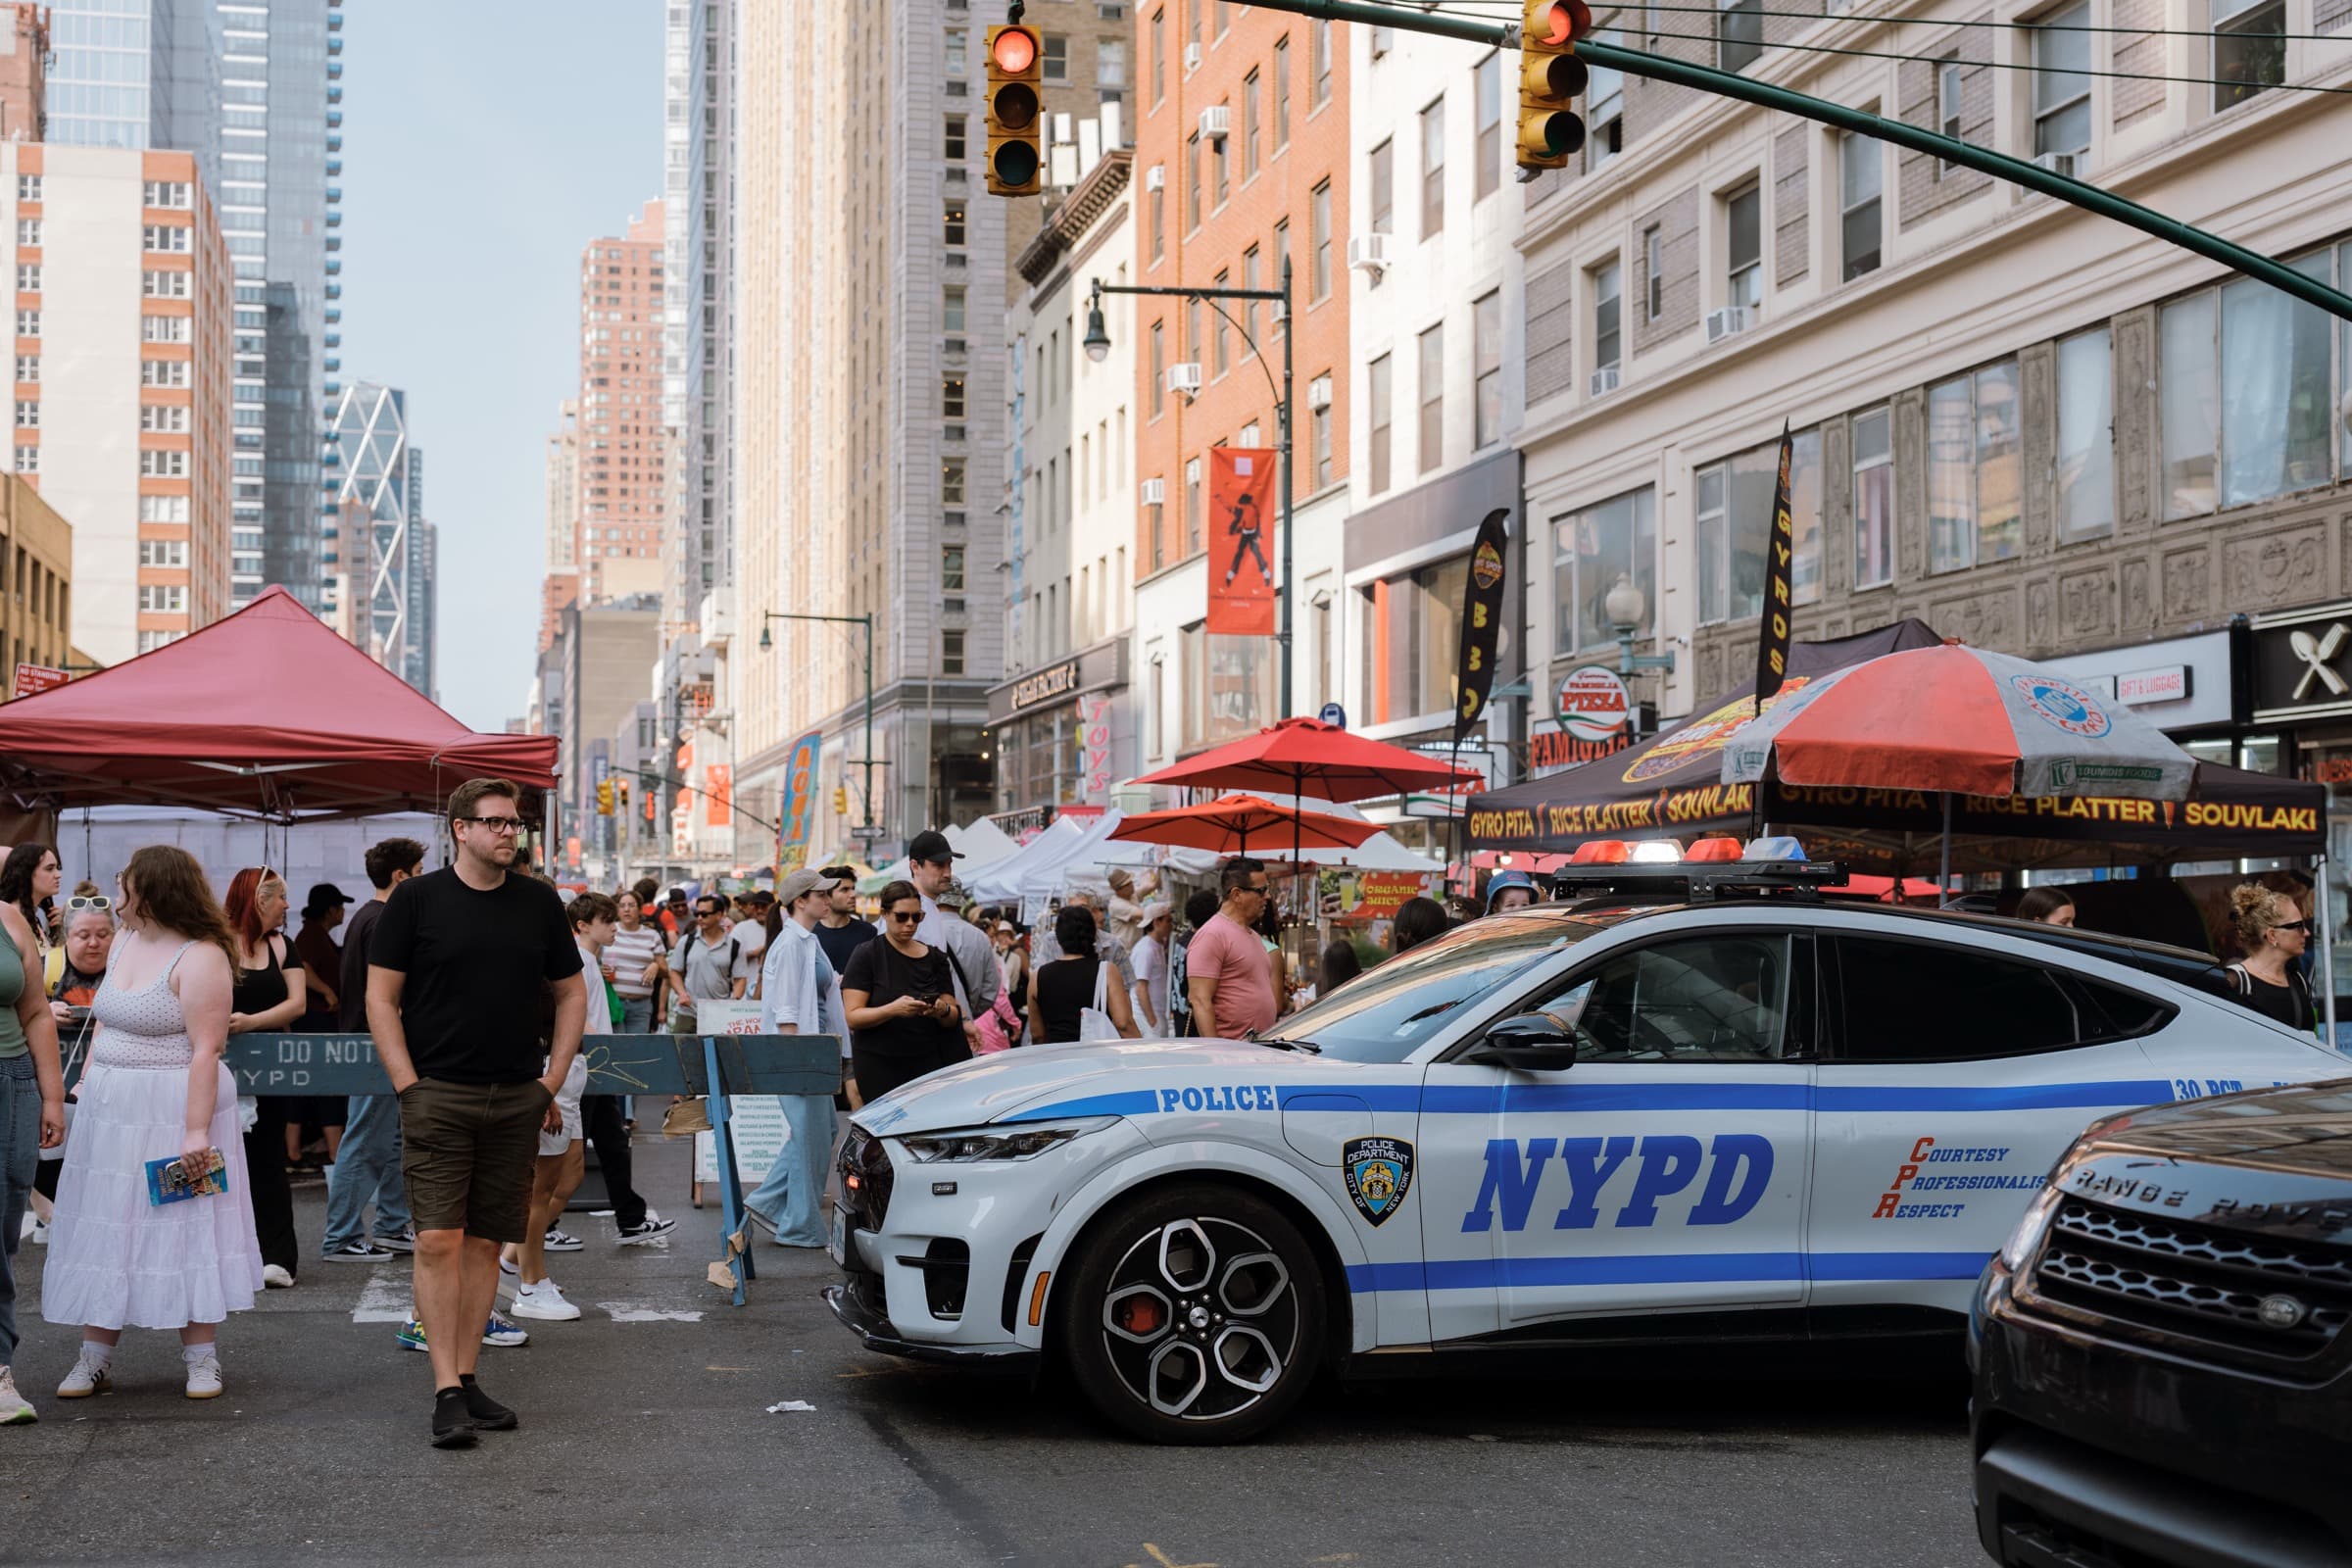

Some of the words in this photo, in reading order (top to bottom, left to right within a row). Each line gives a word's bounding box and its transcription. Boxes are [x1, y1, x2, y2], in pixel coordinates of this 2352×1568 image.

[1769, 508, 1791, 675] GYROS
[30, 669, 61, 681] STANDING
[2121, 679, 2136, 698] GIFT
[2146, 673, 2180, 695] LUGGAGE
[1561, 692, 1627, 712] PIZZA
[1088, 700, 1110, 792] TOYS
[1470, 811, 1504, 839] GYRO
[1505, 808, 1536, 839] PITA
[1549, 805, 1584, 836] RICE
[1584, 799, 1653, 832] PLATTER
[1666, 784, 1753, 824] SOUVLAK
[1780, 785, 1858, 805] GYRO
[1865, 788, 1928, 811] PITA
[1965, 794, 2030, 816] RICE
[2035, 795, 2156, 823] PLATTER
[2185, 803, 2318, 832] SOUVLAKI
[1366, 885, 1418, 895] ORGANIC
[1366, 896, 1401, 906] JUICE
[278, 1041, 311, 1064] DO
[325, 1041, 375, 1064] NOT
[1160, 1086, 1275, 1113] POLICE
[1348, 1149, 1409, 1164] DEPARTMENT
[1361, 1140, 1396, 1150] POLICE
[1347, 1173, 1358, 1194] CITY
[1355, 1197, 1366, 1209] OF
[1460, 1134, 1774, 1233] NYPD
[1890, 1164, 2047, 1191] PROFESSIONALIS
[1386, 1195, 1401, 1212] NEW
[1397, 1171, 1410, 1193] YORK
[2076, 1168, 2189, 1208] RANGE
[2211, 1198, 2350, 1231] ROVE
